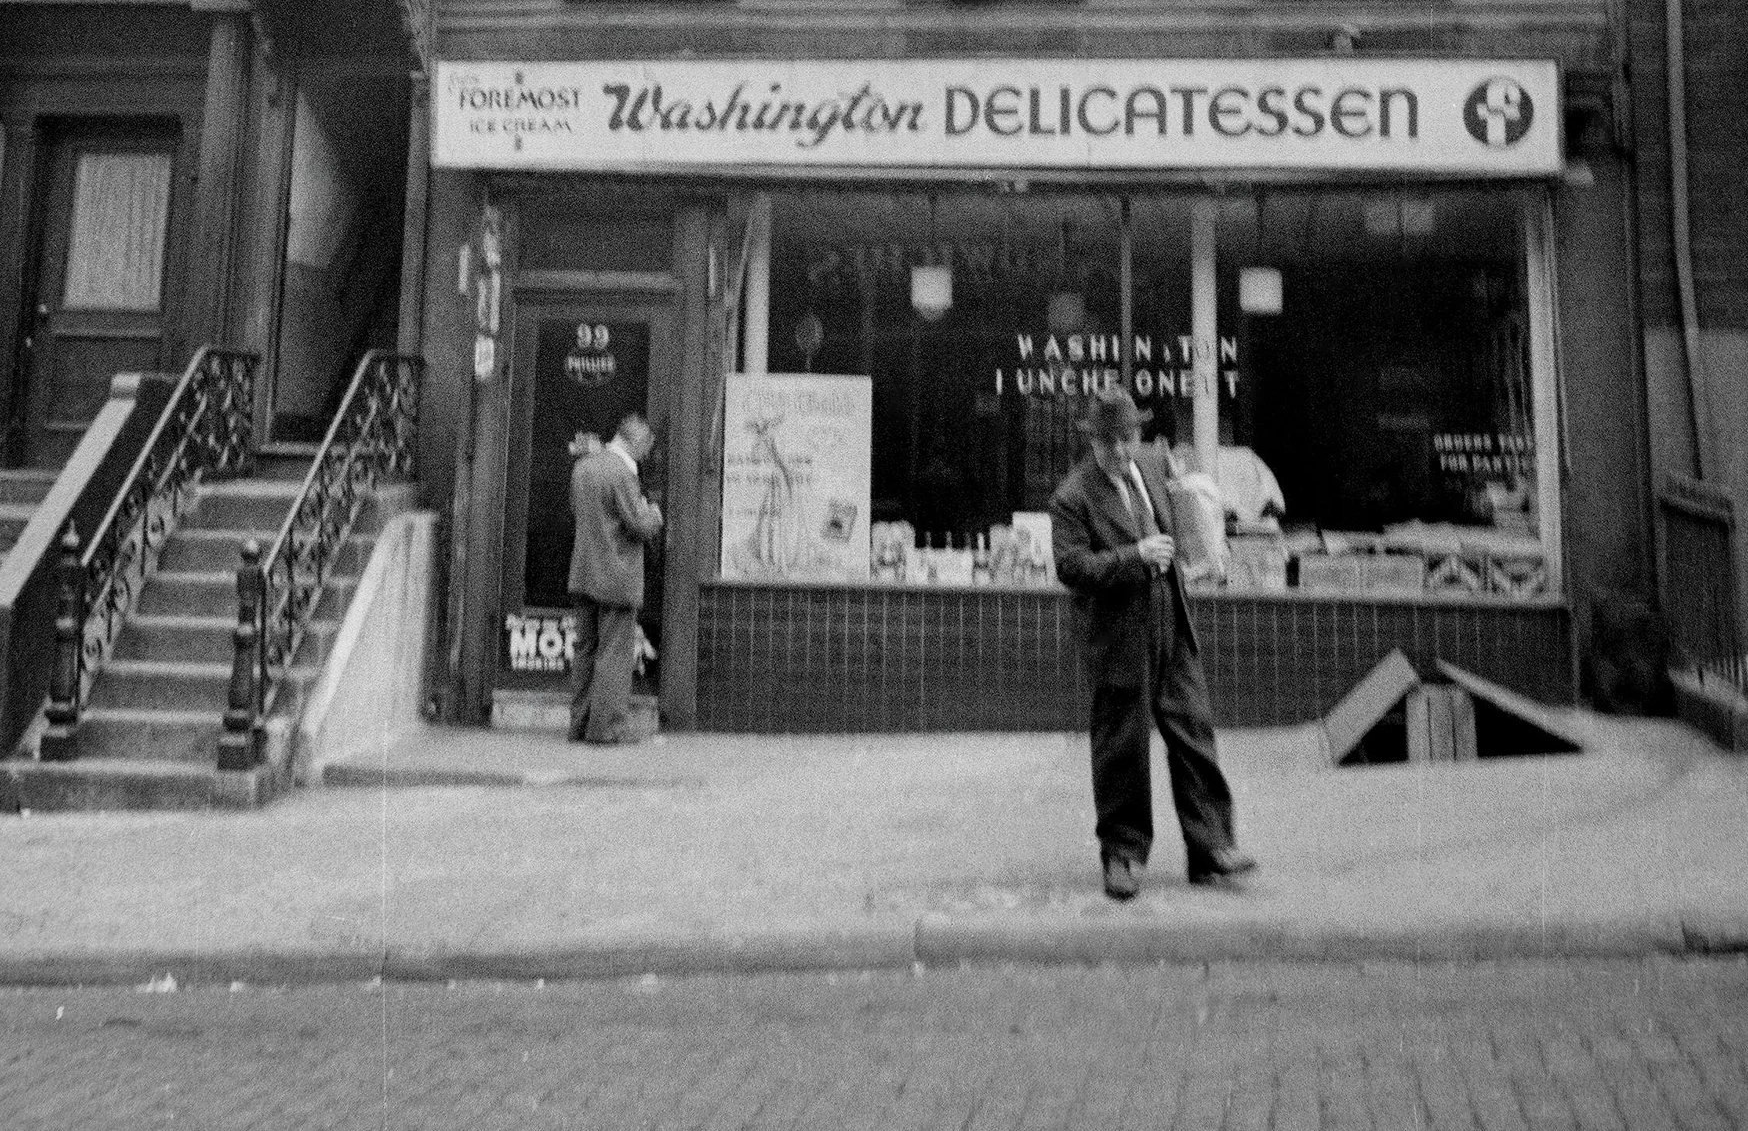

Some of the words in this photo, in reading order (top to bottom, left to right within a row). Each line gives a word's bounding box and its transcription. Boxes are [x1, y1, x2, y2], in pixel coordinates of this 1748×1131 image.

[459, 87, 581, 111] FOREMOST
[602, 80, 924, 147] Washington
[943, 85, 1418, 139] DELICATESSEN
[469, 118, 496, 134] ICE
[502, 118, 573, 135] CREAM
[576, 323, 610, 350] 99
